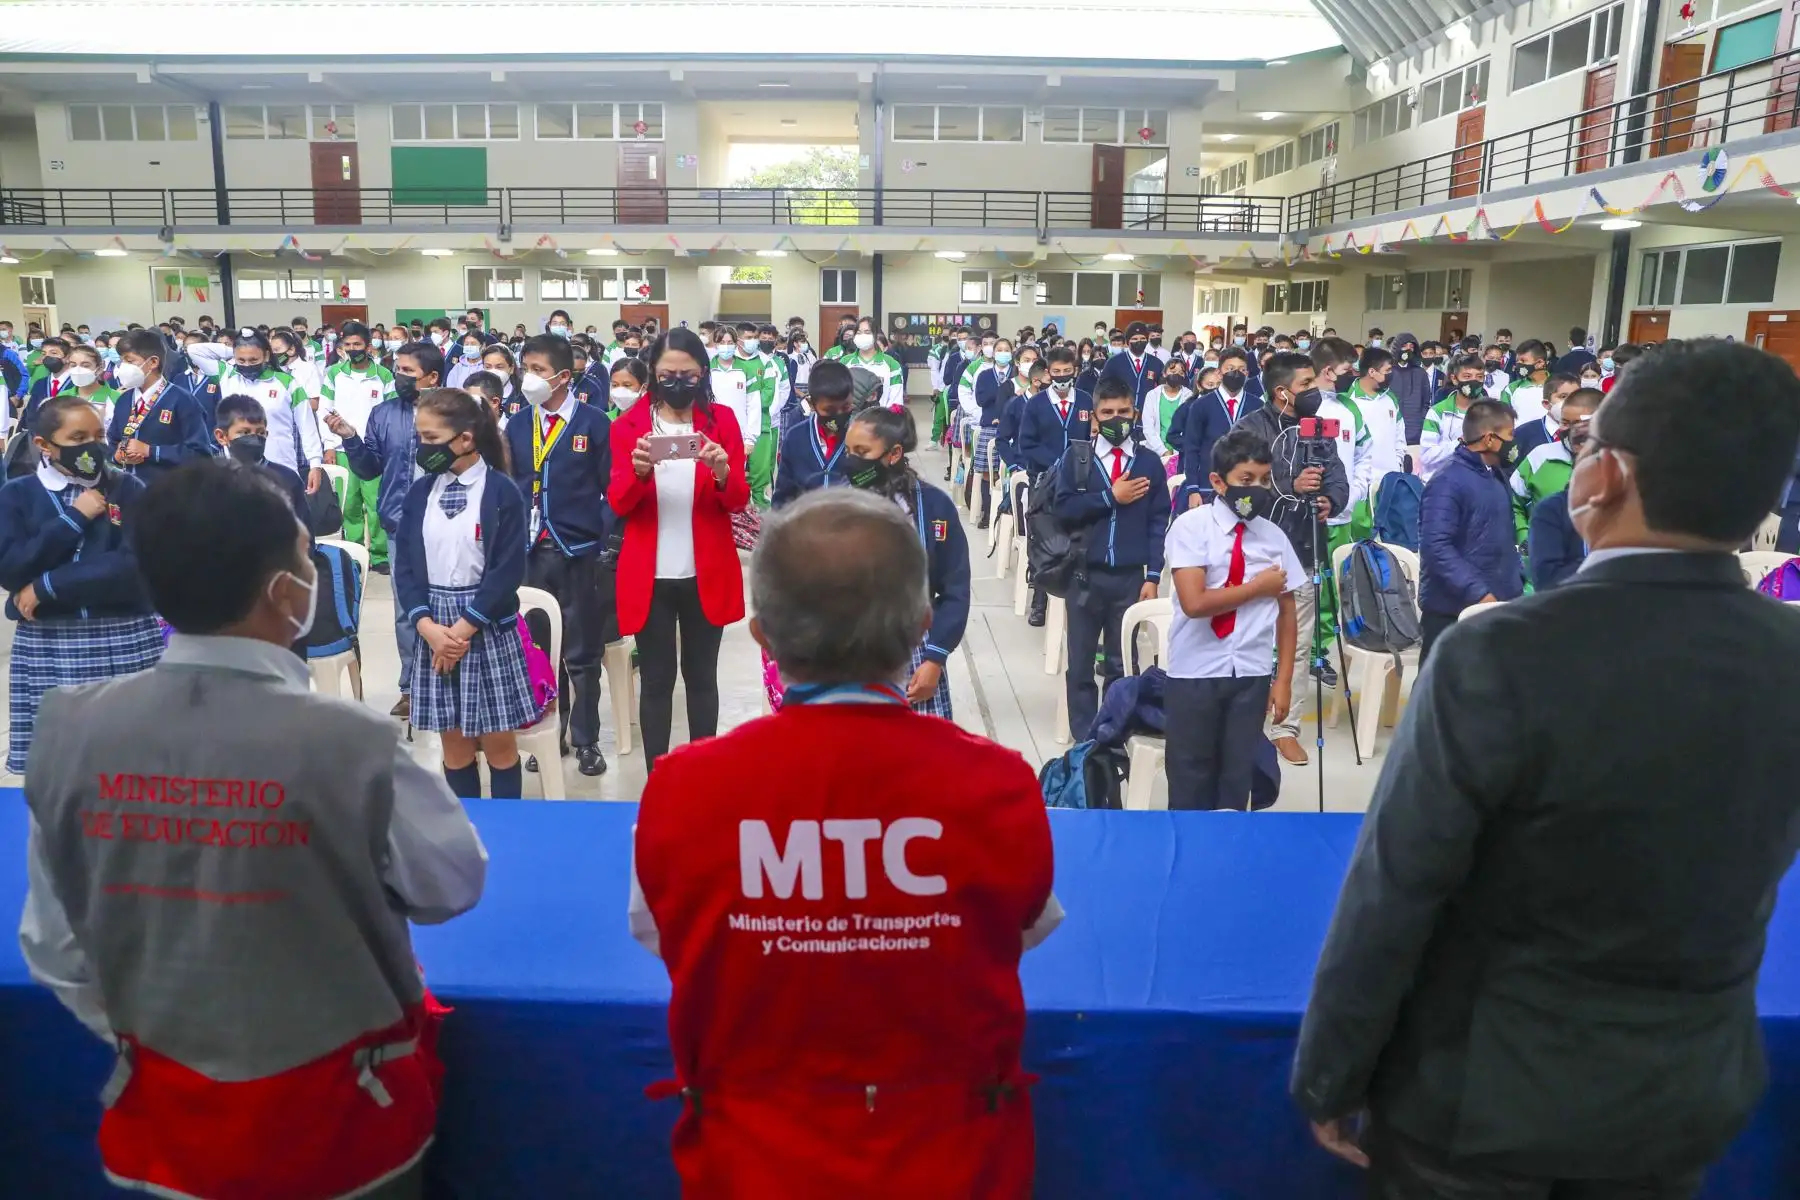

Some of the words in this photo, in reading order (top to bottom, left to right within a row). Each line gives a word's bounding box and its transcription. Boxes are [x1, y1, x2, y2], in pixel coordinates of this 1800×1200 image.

[97, 773, 285, 809] MINISTERIO
[739, 817, 947, 899] MTC
[729, 914, 821, 932] Ministerio
[827, 914, 848, 931] de
[853, 912, 961, 934] Transportes
[762, 938, 773, 955] y
[777, 934, 930, 953] Comunicaciones
